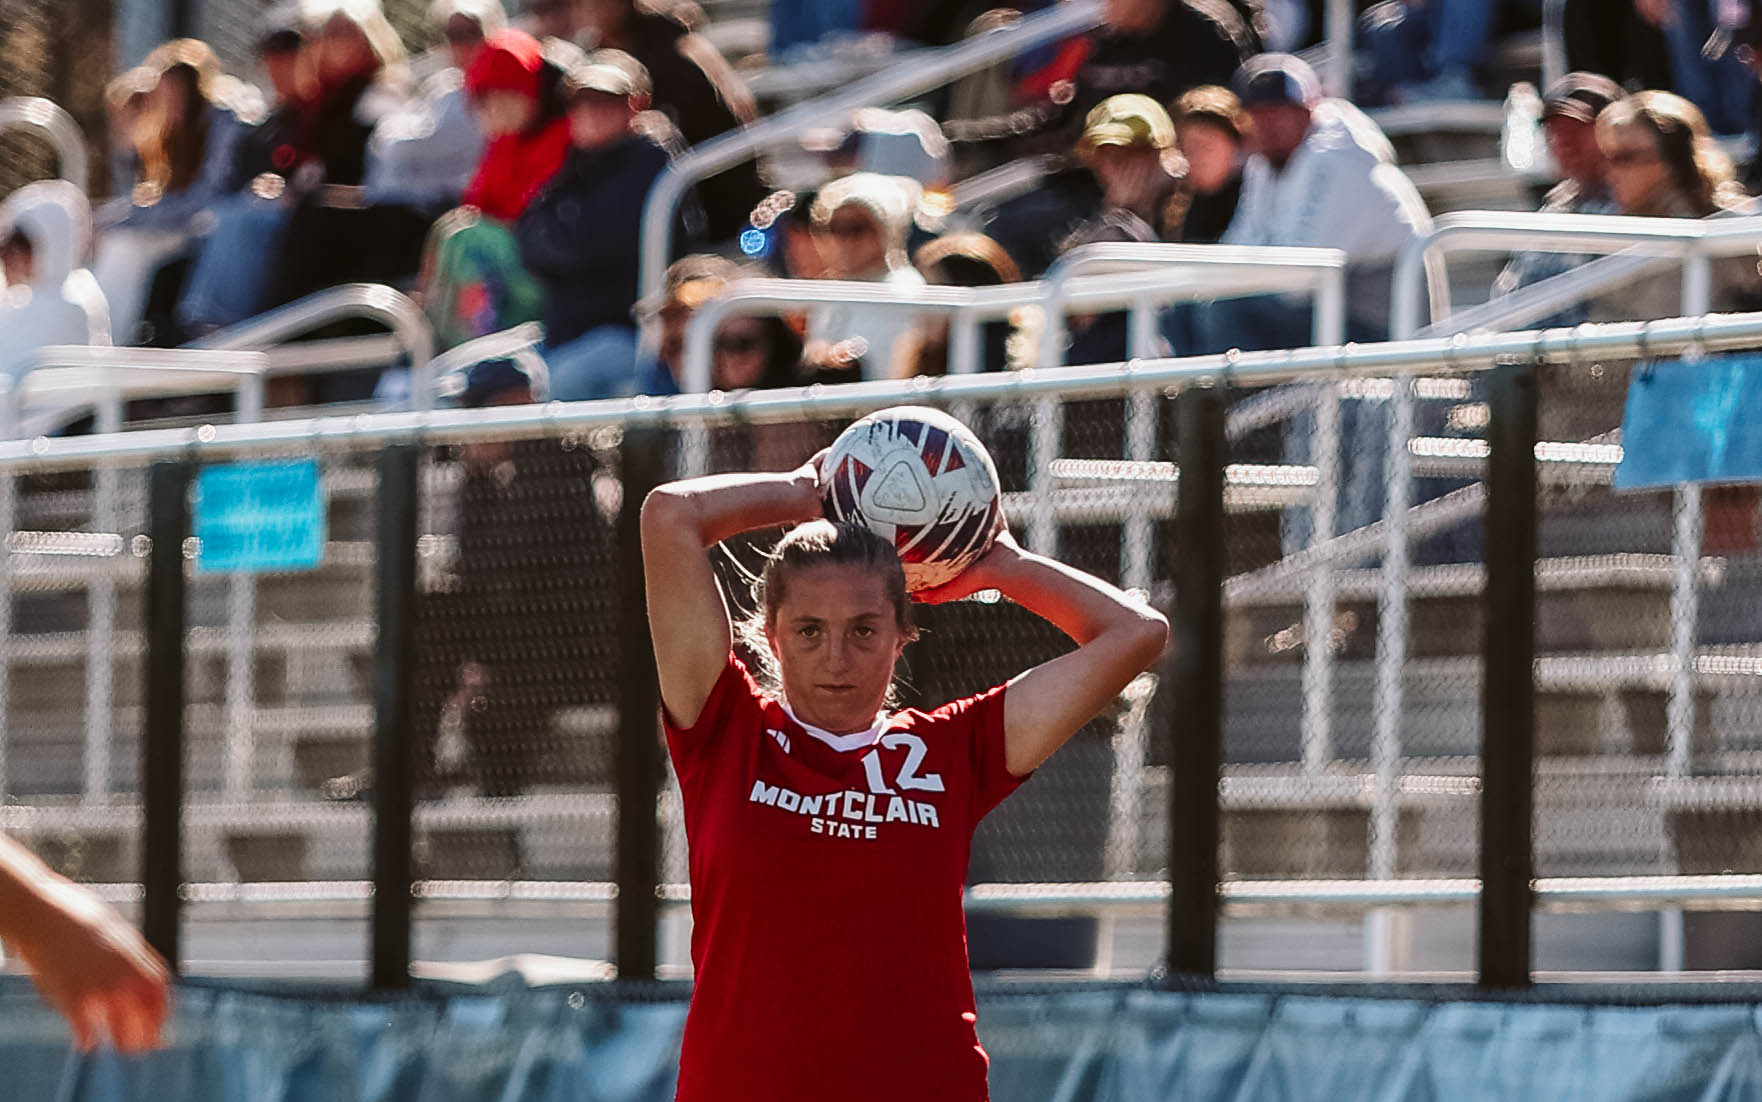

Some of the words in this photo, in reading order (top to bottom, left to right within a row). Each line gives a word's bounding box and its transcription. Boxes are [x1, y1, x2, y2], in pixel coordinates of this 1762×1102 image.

[861, 733, 945, 795] 12
[750, 780, 940, 828] MONTCLAIR
[810, 818, 877, 839] STATE
